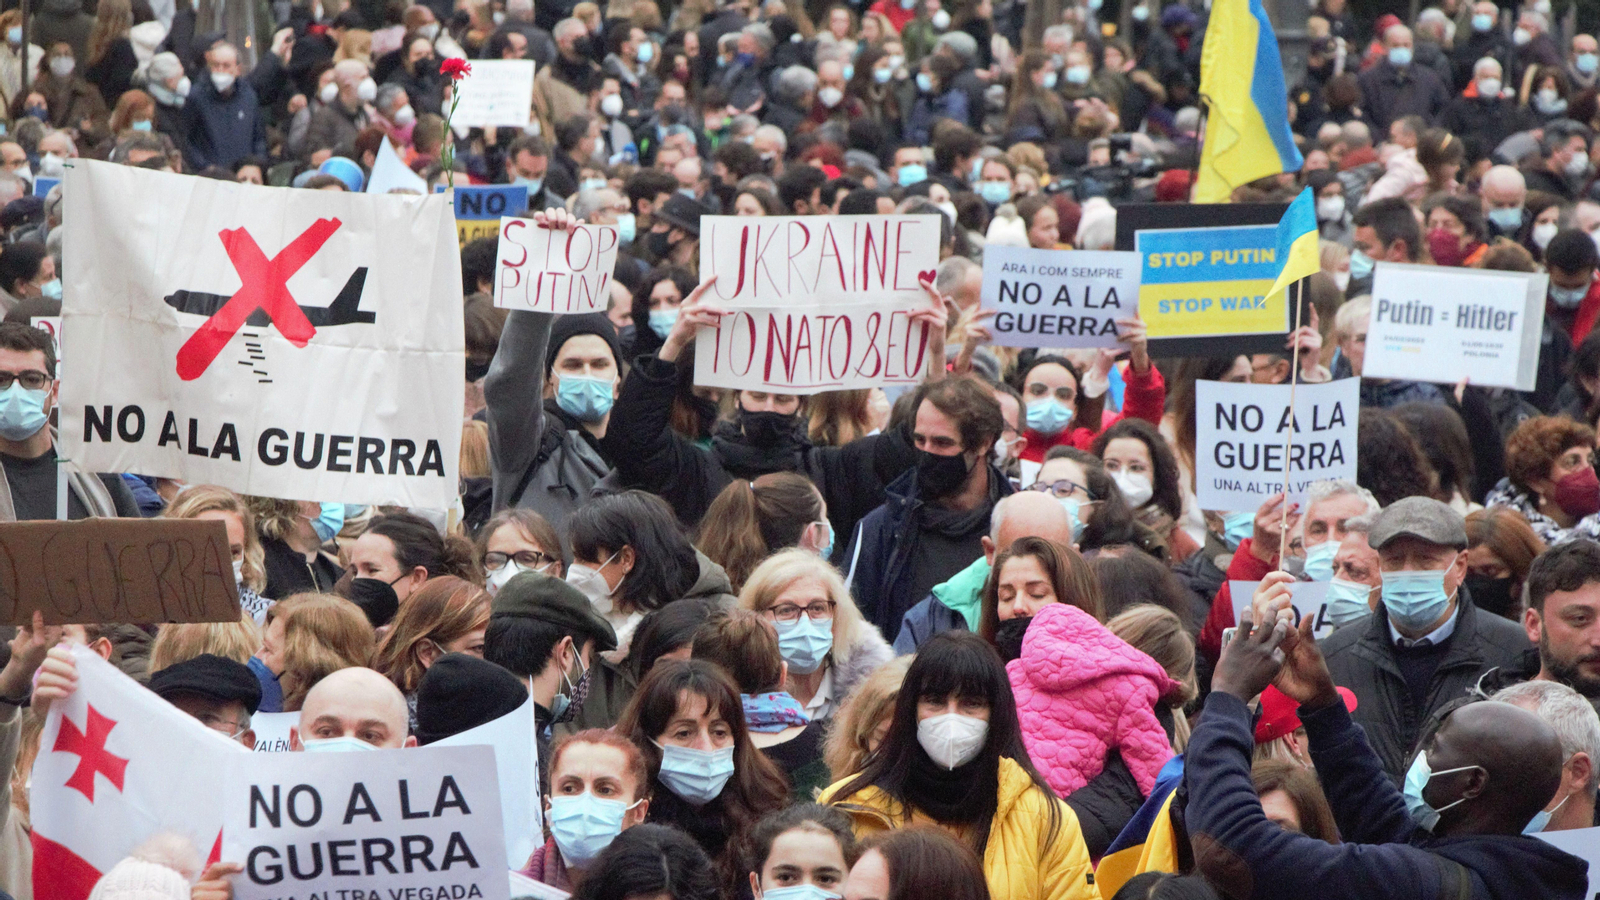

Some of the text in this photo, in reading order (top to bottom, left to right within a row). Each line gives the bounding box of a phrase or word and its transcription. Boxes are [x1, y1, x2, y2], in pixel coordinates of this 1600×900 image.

[460, 192, 507, 216] NO
[502, 220, 617, 272] STOP
[712, 220, 921, 301] UKRAINE
[1149, 248, 1275, 268] STOP PUTIN
[1002, 262, 1123, 279] ARA I COM SEMPRE
[500, 266, 608, 312] PUTIN!
[999, 280, 1121, 309] NO A LA
[1158, 296, 1266, 314] STOP WAR
[995, 311, 1119, 336] GUERRA
[1377, 298, 1434, 326] Putin
[1456, 304, 1518, 332] Hitler
[707, 310, 757, 377] TO
[763, 313, 852, 383] NATO
[1215, 401, 1346, 434] NO A LA
[83, 404, 446, 477] NO A LA GUERRA
[1214, 439, 1345, 472] GUERRA
[1214, 478, 1243, 491] UNA
[1246, 482, 1293, 495] ALTRA
[42, 531, 238, 621] GUERRA
[249, 775, 472, 828] NO A LA
[246, 831, 480, 886] GUERRA
[387, 883, 483, 900] VEGADA
